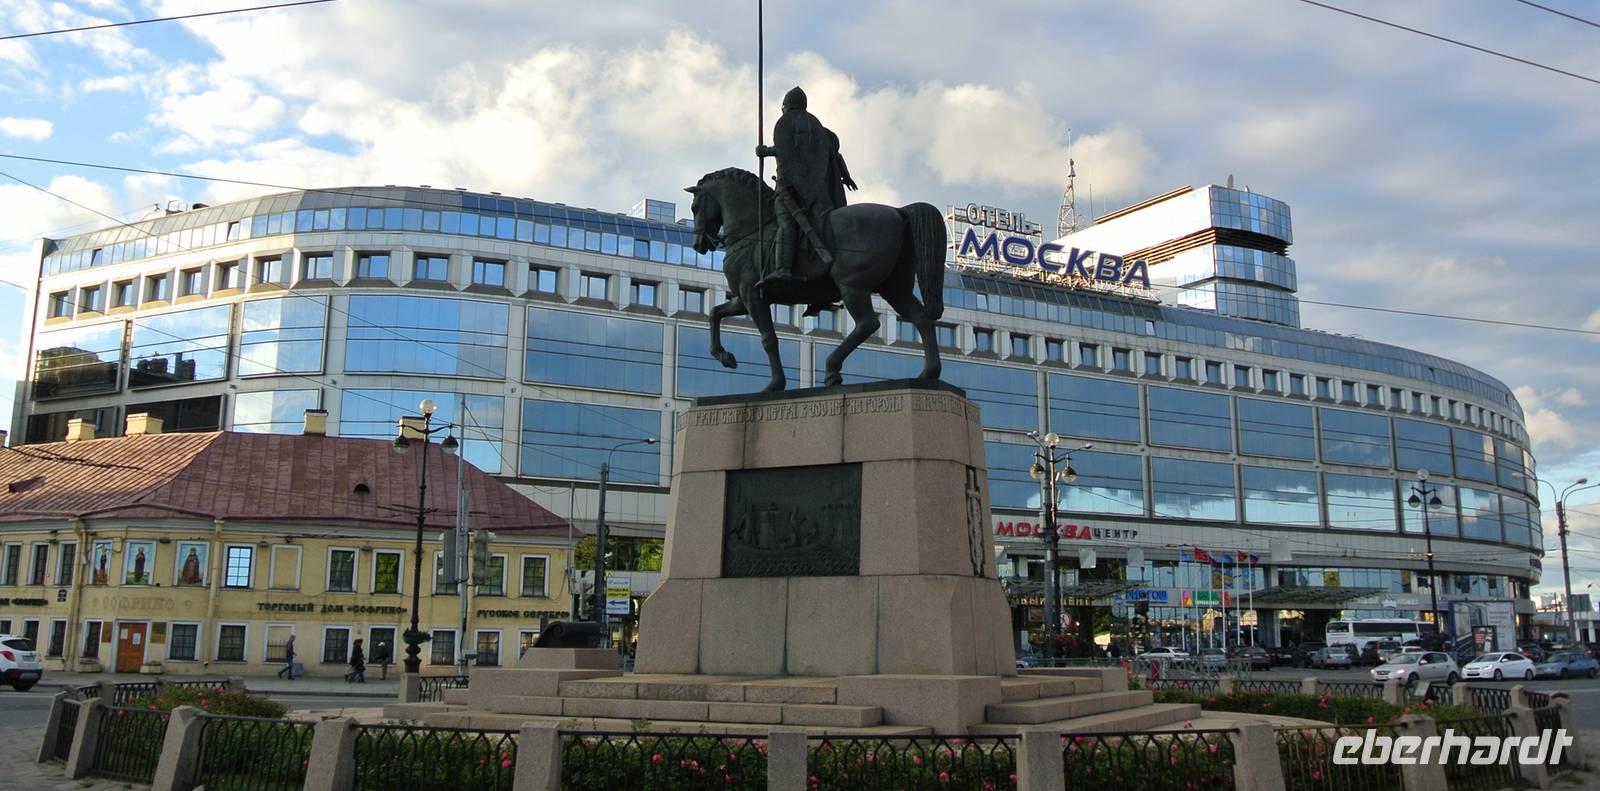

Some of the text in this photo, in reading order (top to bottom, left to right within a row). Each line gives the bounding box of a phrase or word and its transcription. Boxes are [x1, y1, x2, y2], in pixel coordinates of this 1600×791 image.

[966, 202, 1033, 235] ОТЕЛЬ
[957, 227, 1151, 288] МОСКВА
[996, 521, 1138, 540] МОВА ЦЕНТР
[256, 602, 314, 613] ТОРГОВЫЙ
[320, 604, 344, 614] ДОМ
